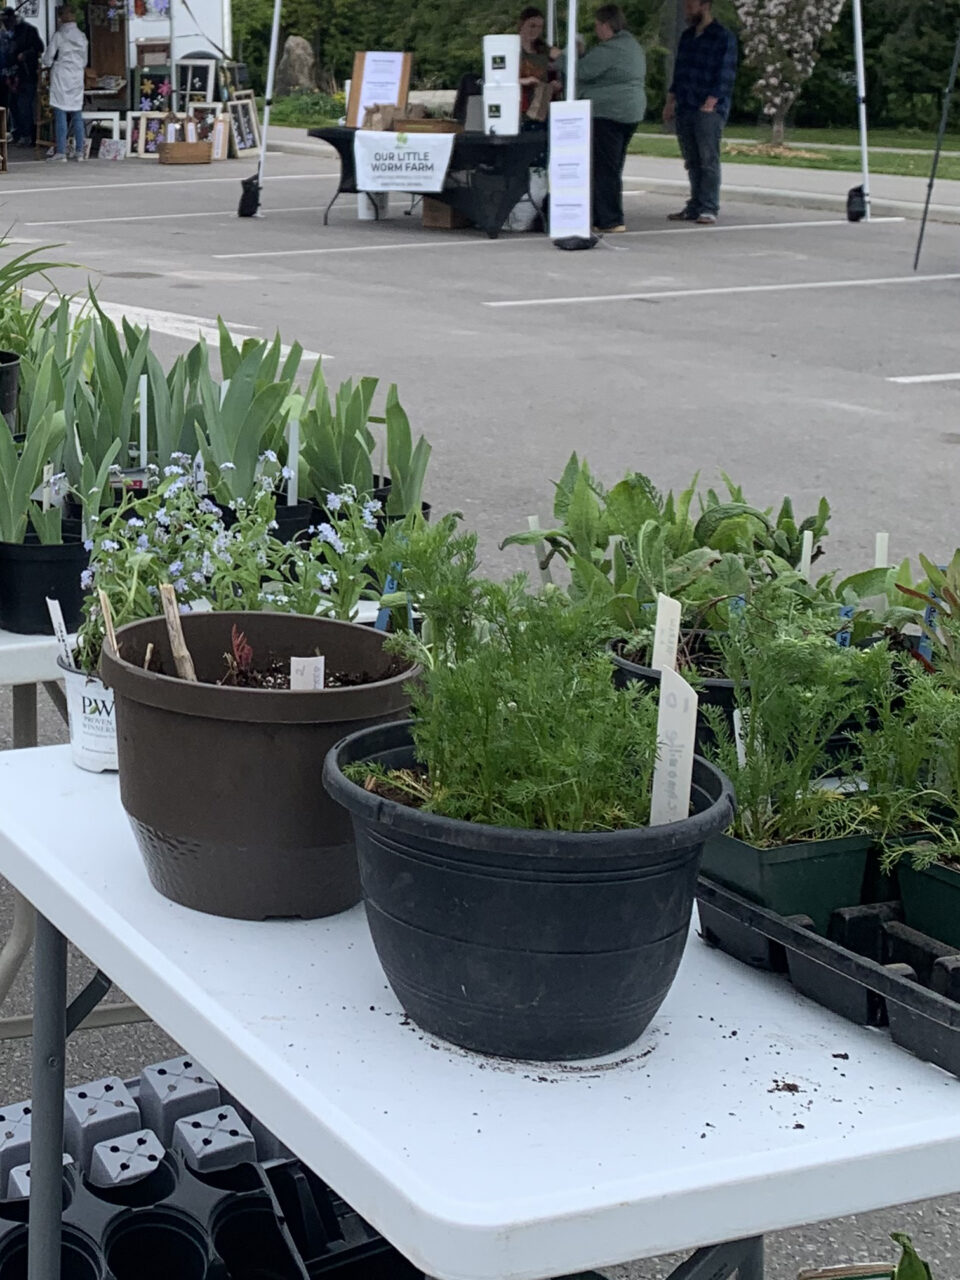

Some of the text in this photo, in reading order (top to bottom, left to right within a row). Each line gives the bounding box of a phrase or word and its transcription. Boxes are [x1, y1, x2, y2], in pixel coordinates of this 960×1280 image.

[374, 152, 430, 161] OUR LITTLE
[371, 163, 435, 172] WORM FARM
[82, 696, 116, 718] PW
